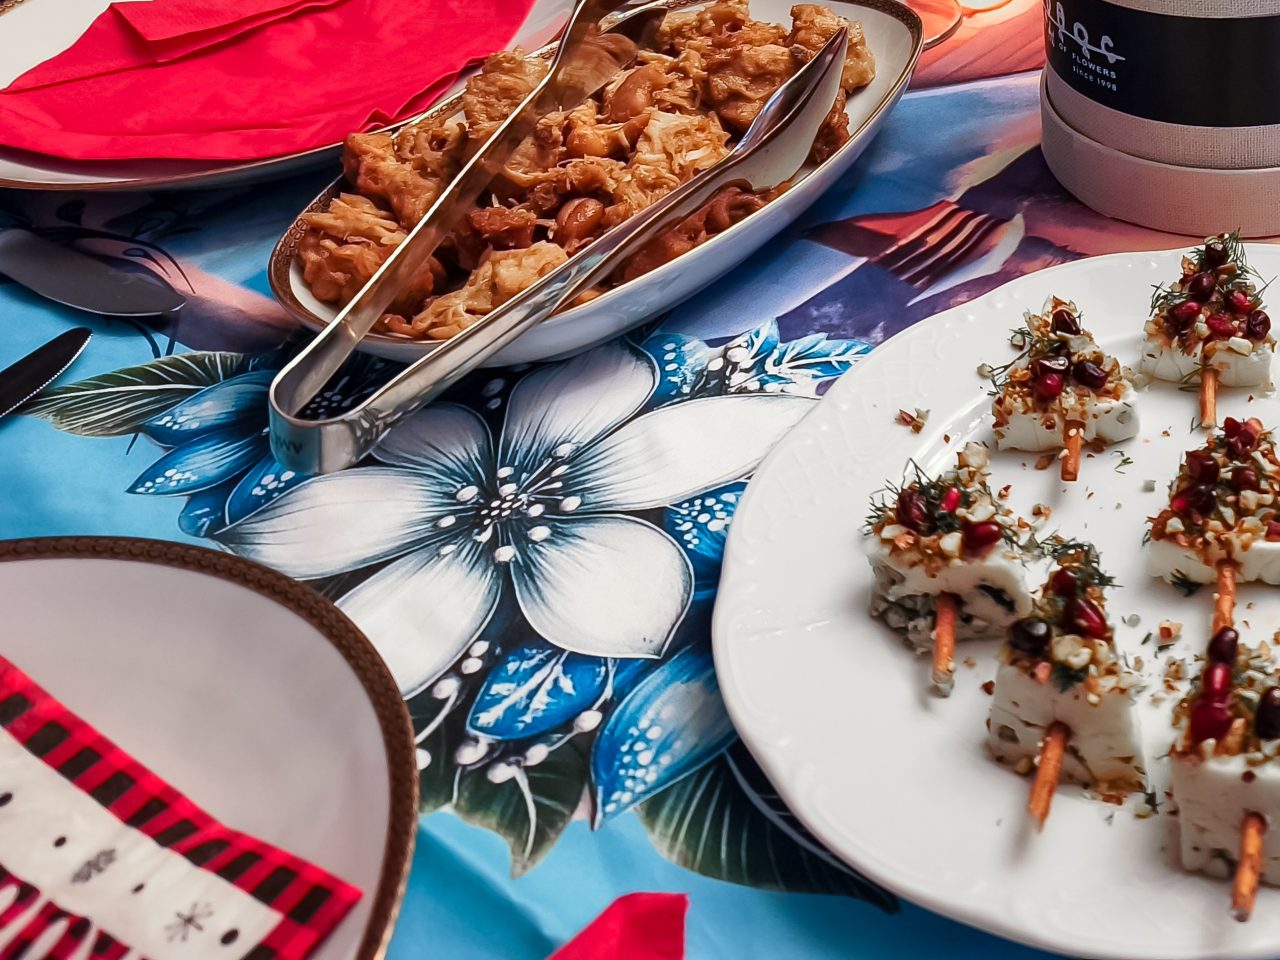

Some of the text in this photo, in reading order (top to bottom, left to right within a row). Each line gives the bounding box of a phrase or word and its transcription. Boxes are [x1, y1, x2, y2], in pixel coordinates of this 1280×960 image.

[1072, 52, 1117, 79] FLOWERS
[1072, 65, 1117, 92] since 1998
